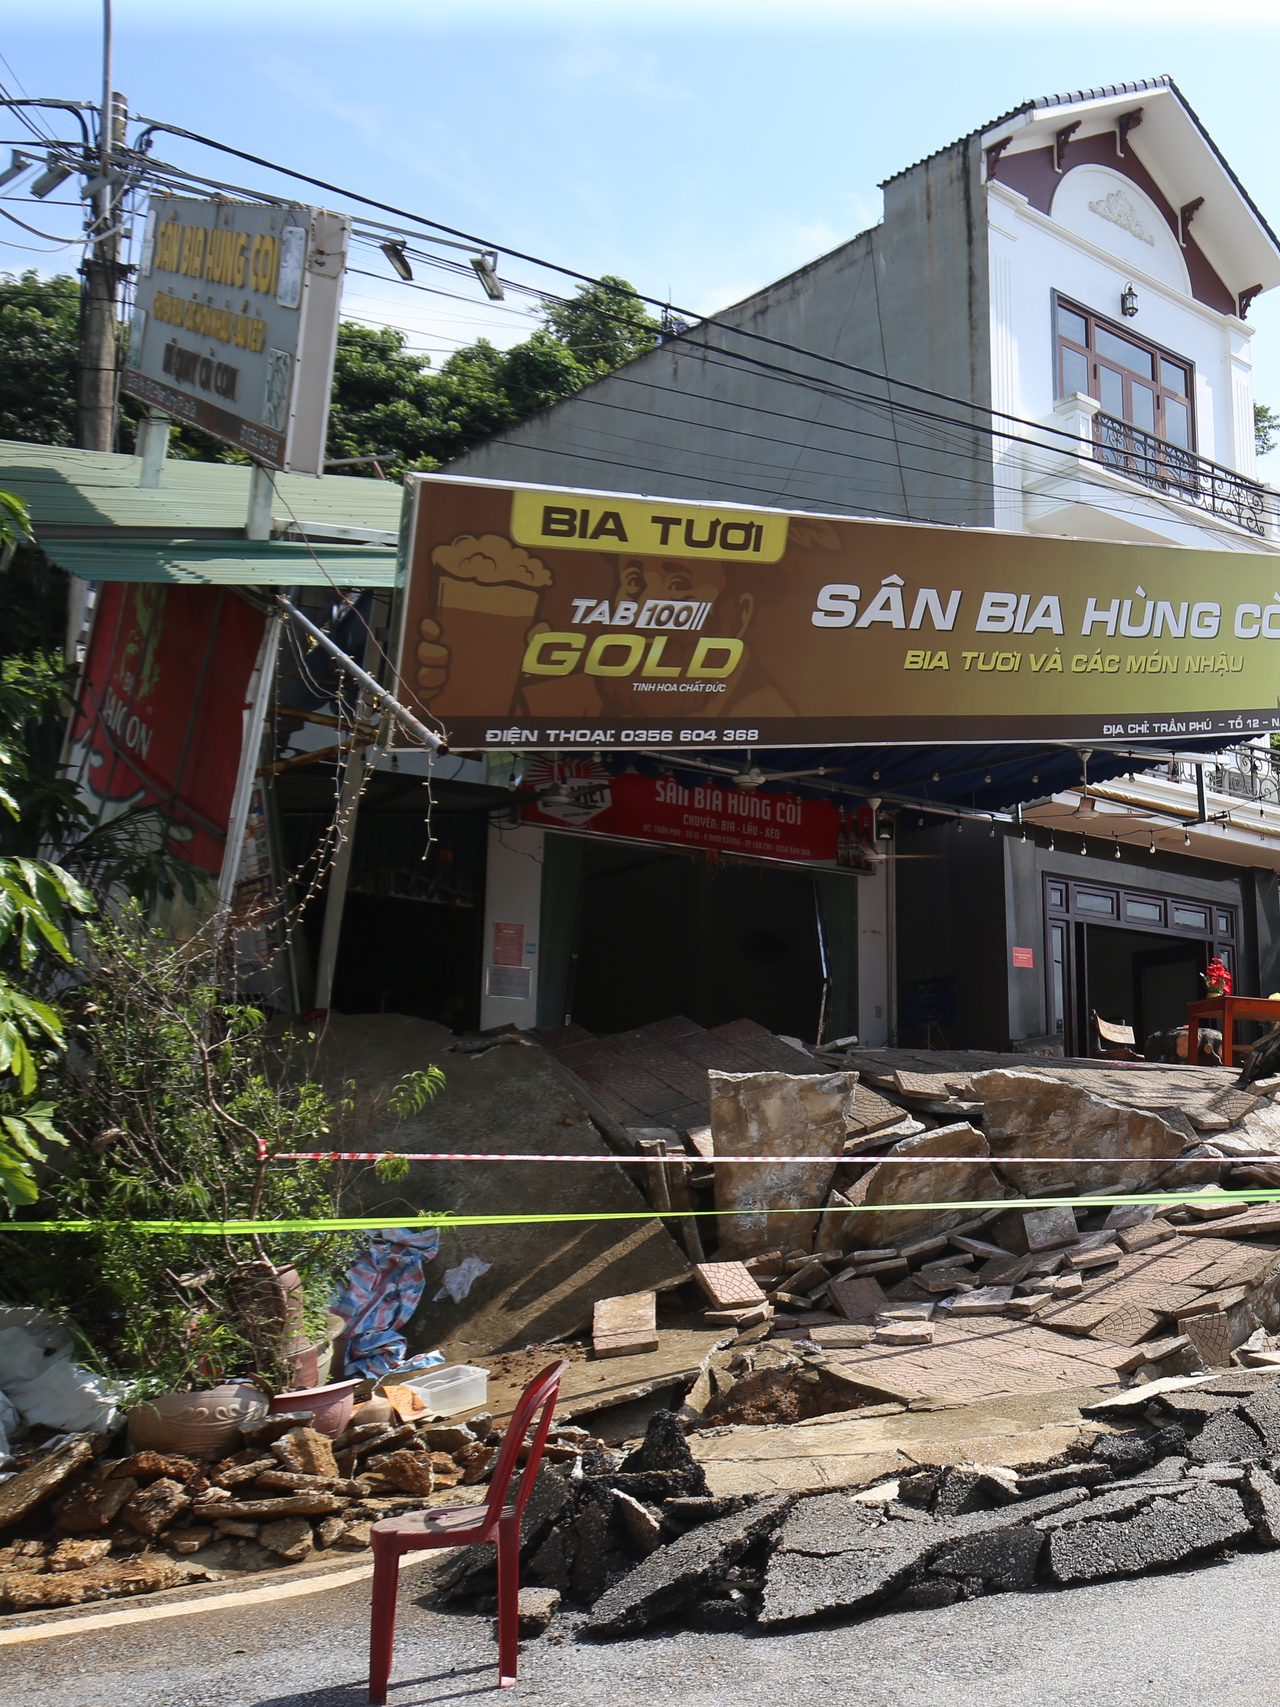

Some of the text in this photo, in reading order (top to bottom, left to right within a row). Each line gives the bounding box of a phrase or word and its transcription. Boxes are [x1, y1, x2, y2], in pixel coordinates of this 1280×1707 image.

[181, 226, 205, 277] BIA
[541, 505, 764, 553] BIA TƯƠI
[811, 573, 962, 632] SÂN
[976, 591, 1065, 635] BIA
[1080, 584, 1223, 639] HÙNG
[521, 631, 745, 679] GOLD
[903, 647, 1244, 677] BIA TƯƠI VÀ CÁC MÓN NHẬU
[632, 680, 727, 693] TINH HOA CHẤT ĐỨC
[485, 726, 759, 745] ĐIỆN THOẠI: 0356 604 368
[1103, 724, 1124, 737] ĐỊA
[1153, 721, 1186, 733] TRẦN
[1189, 719, 1212, 732] PHÚ
[1228, 717, 1243, 729] TỔ
[1247, 719, 1259, 729] 12
[655, 777, 802, 825] SÂN BIA HÙNG CÒI
[683, 813, 719, 830] CHUYÊN:
[721, 820, 735, 832] BIA
[765, 825, 780, 840] XÈO
